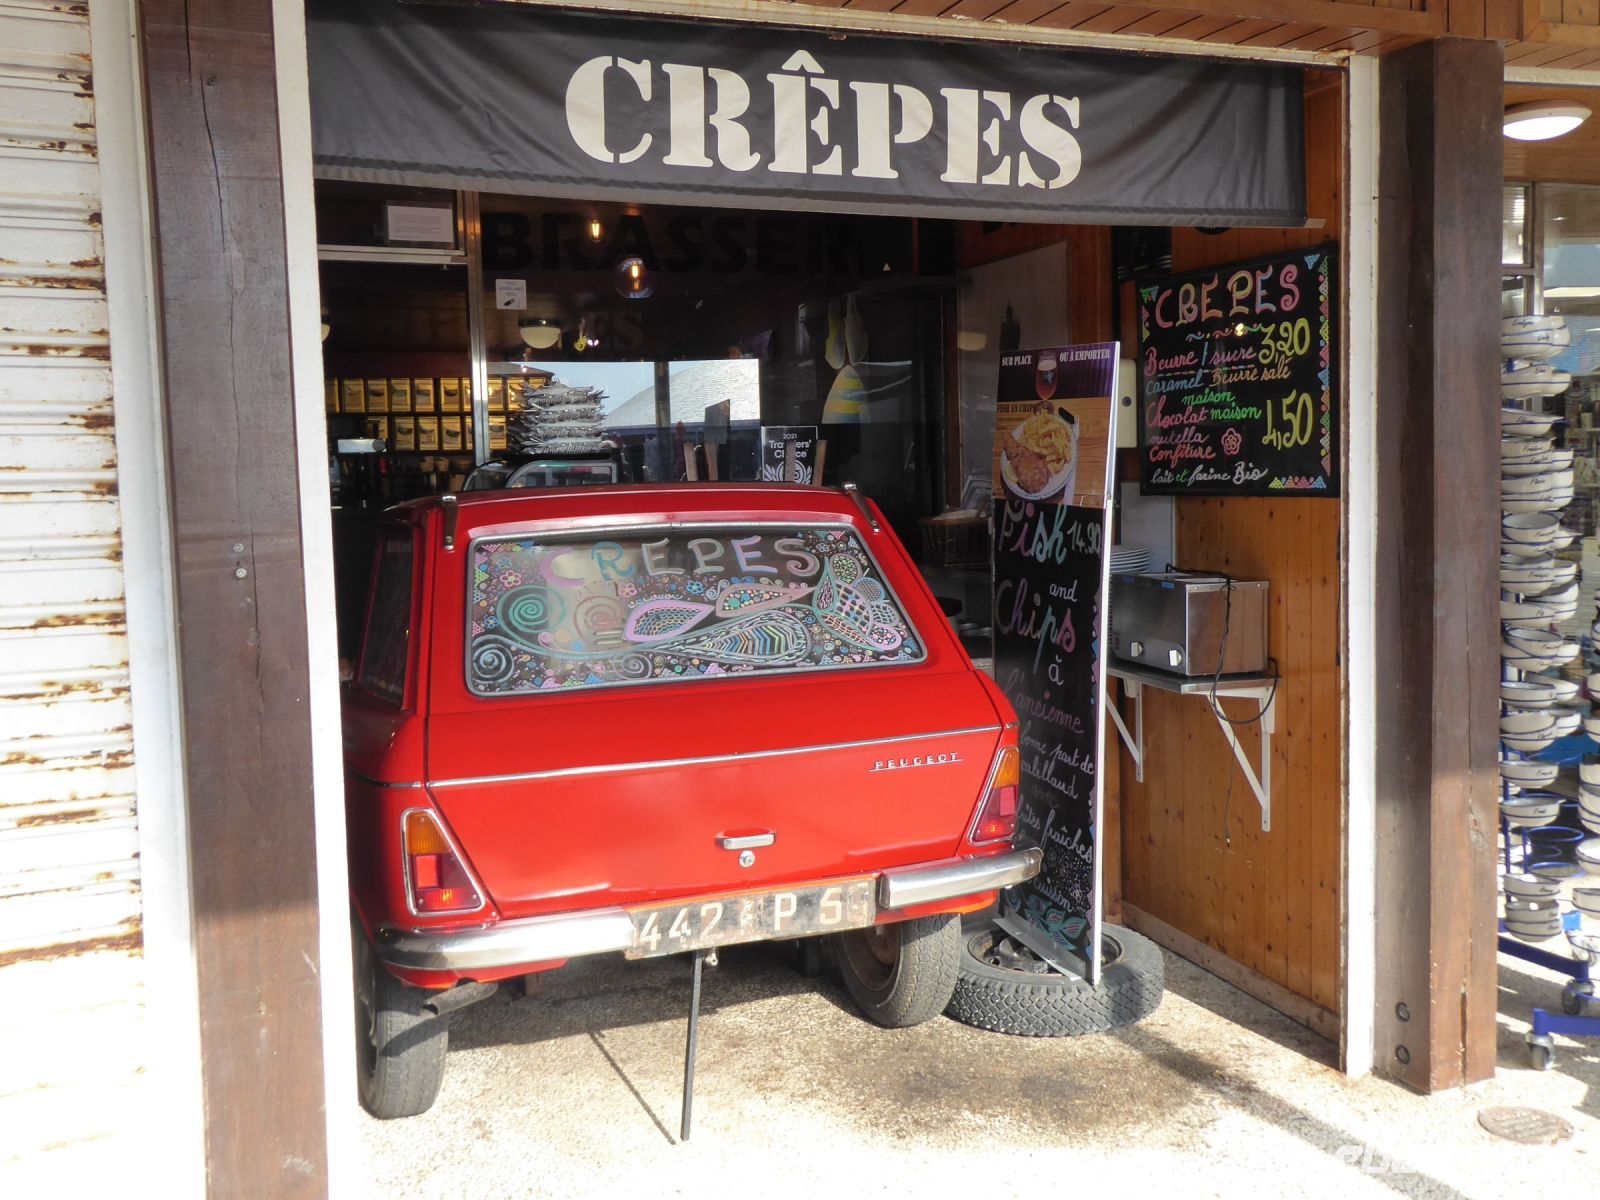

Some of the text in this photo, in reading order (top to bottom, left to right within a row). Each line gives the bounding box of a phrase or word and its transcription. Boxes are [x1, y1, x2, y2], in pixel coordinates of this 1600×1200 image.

[565, 49, 1082, 190] CRÊPES
[1059, 352, 1069, 362] OU
[1075, 349, 1111, 361] EMPORTER
[1258, 317, 1311, 365] 3,20
[1014, 355, 1033, 366] PLACE
[1143, 346, 1199, 377] Beurre
[1208, 346, 1258, 366] sucre
[1208, 367, 1260, 387] Beurre
[1260, 355, 1294, 382] salé
[1181, 387, 1237, 406] maison
[1145, 394, 1263, 429] Chocolat maison
[1150, 425, 1211, 446] nutella
[1149, 443, 1217, 469] Confiture
[1151, 460, 1269, 487] lait et farine Bio
[539, 534, 820, 583] CREPES
[1050, 579, 1078, 602] and
[995, 578, 1076, 675] Chips
[874, 752, 958, 771] PEUGEOT
[1049, 743, 1079, 768] part
[1080, 754, 1095, 775] de
